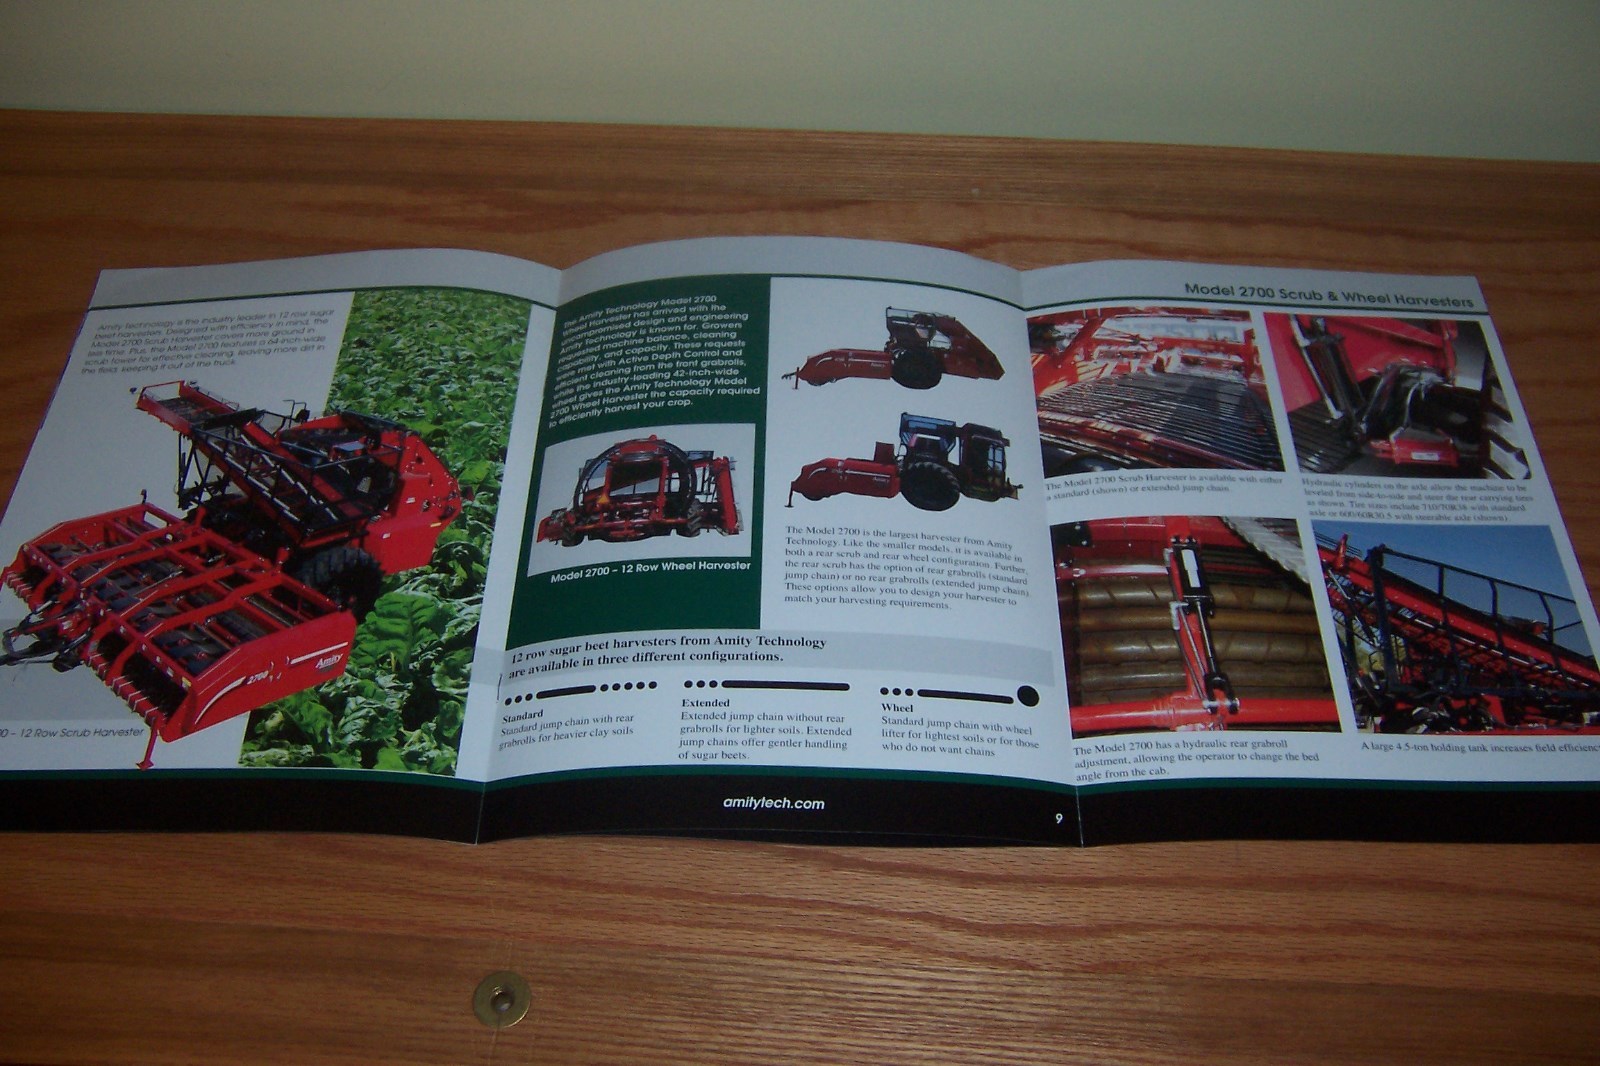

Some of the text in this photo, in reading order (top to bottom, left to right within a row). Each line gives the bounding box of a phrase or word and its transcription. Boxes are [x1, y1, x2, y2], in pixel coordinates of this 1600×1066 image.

[1185, 283, 1475, 308] Model 2700 Scrub & Wheel Harvesters
[579, 390, 603, 401] gives
[605, 386, 621, 395] the
[623, 383, 651, 392] Amity
[654, 379, 711, 388] Technology
[714, 377, 747, 385] Model
[550, 387, 760, 419] 2700 Wheel Harvester the capacity required
[558, 408, 602, 424] efficiently
[605, 402, 640, 413] harvest
[642, 400, 665, 410] your
[667, 399, 693, 407] crop.
[785, 525, 1013, 551] The Model 2700 is the largest harvester from Amity
[785, 536, 840, 547] Technology.
[843, 539, 864, 547] Like
[866, 540, 880, 548] the
[882, 541, 916, 550] smaller
[964, 547, 971, 555] is
[973, 549, 1012, 561] available
[1014, 553, 1023, 563] in
[551, 570, 583, 583] Model
[585, 566, 610, 578] 2700
[622, 564, 634, 573] 12
[635, 563, 660, 572] Row
[661, 561, 696, 571] Wheel
[698, 561, 752, 571] Harvester
[511, 635, 827, 664] 12 row sugar beet harvesters from Amity Technology
[508, 651, 784, 679] are available in three different configurations.
[682, 699, 730, 708] Extended
[881, 703, 914, 713] Wheel
[501, 714, 634, 736] Standard jump chain with rear
[502, 709, 544, 724] Standard
[681, 711, 845, 723] Extended jump chain without rear
[20, 728, 33, 738] 12
[33, 728, 58, 738] Row
[60, 728, 90, 738] Scrub
[93, 727, 144, 737] Harvester
[680, 724, 853, 736] grabrolls for lighter soils. Extended
[881, 716, 1033, 736] Standard jump chain with wheel
[498, 726, 634, 751] grabrolls for heavier clay soils
[678, 738, 848, 750] jump chains offer gentler handling
[881, 728, 1040, 749] lifter for lightest soils or for those
[678, 751, 750, 761] of sugar beets.
[882, 742, 996, 757] who do not want chains
[1073, 747, 1092, 756] The
[1094, 743, 1126, 754] Model
[1129, 741, 1153, 751] 2700
[1155, 740, 1172, 749] has
[1183, 739, 1227, 750] hydraulic
[1230, 740, 1248, 748] rear
[1251, 739, 1288, 750] grabroll
[1361, 741, 1370, 750] A
[1371, 741, 1393, 752] large
[1430, 743, 1466, 754] holding
[1468, 743, 1489, 752] tank
[1491, 743, 1533, 752] increases
[1535, 743, 1556, 752] field
[1558, 743, 1600, 752] efficienc
[1074, 752, 1320, 769] adjustment, allowing the operator to change the bed
[1076, 767, 1170, 782] angle from the cab.
[723, 796, 825, 810] amitytech.com
[1055, 812, 1063, 824] 9
